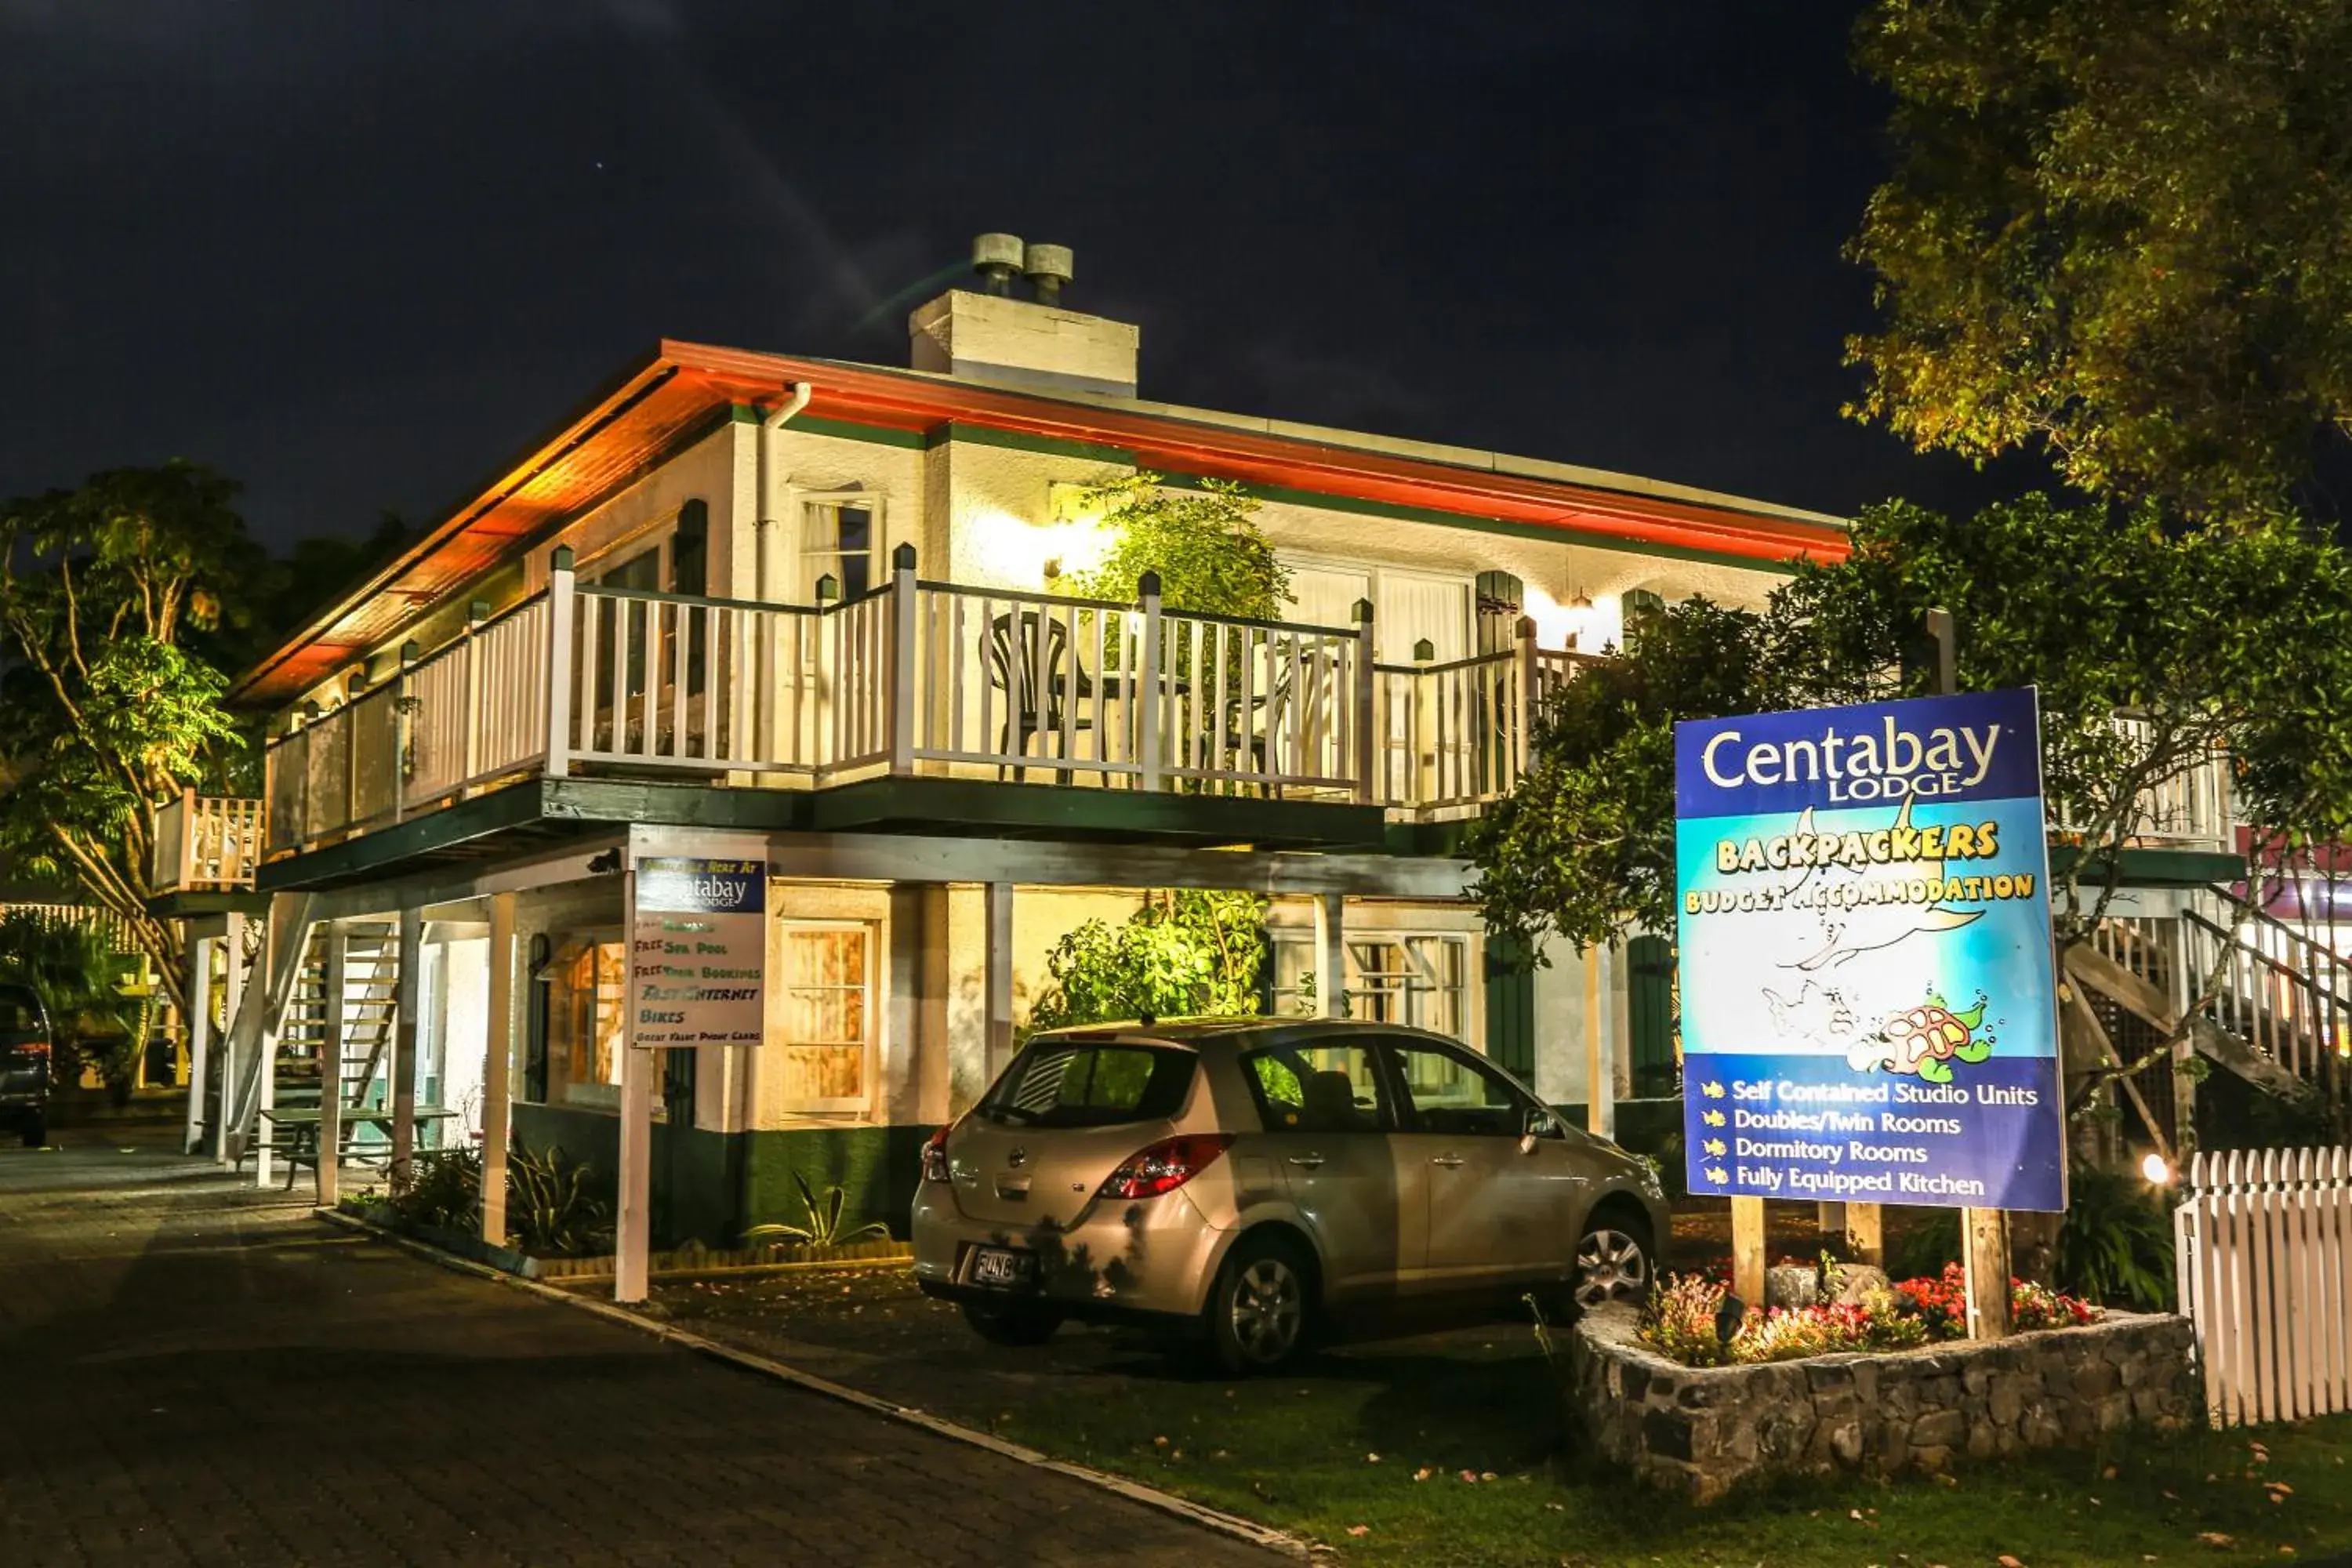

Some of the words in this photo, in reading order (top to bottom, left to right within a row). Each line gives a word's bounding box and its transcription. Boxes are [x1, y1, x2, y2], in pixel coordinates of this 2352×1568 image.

[1703, 715, 2001, 787] Centabay
[1829, 771, 1963, 801] LODGE
[1716, 822, 2000, 874] BACKPACKERS
[1684, 886, 1787, 914] BUDGET
[1792, 872, 2035, 909] ACCOMMODATION
[1732, 1080, 1773, 1101] Self
[1777, 1080, 1889, 1102] Contained
[1896, 1082, 1970, 1106] Studio
[1976, 1084, 2038, 1106] Units
[1734, 1109, 1875, 1133] Doubles/Twin
[1881, 1112, 1962, 1134] Rooms
[1736, 1137, 1843, 1164] Dormitory
[1849, 1145, 1928, 1163] Rooms
[1737, 1167, 1783, 1191] Fully
[1789, 1169, 1893, 1194] Equipped
[1899, 1173, 1984, 1196] Kitchen
